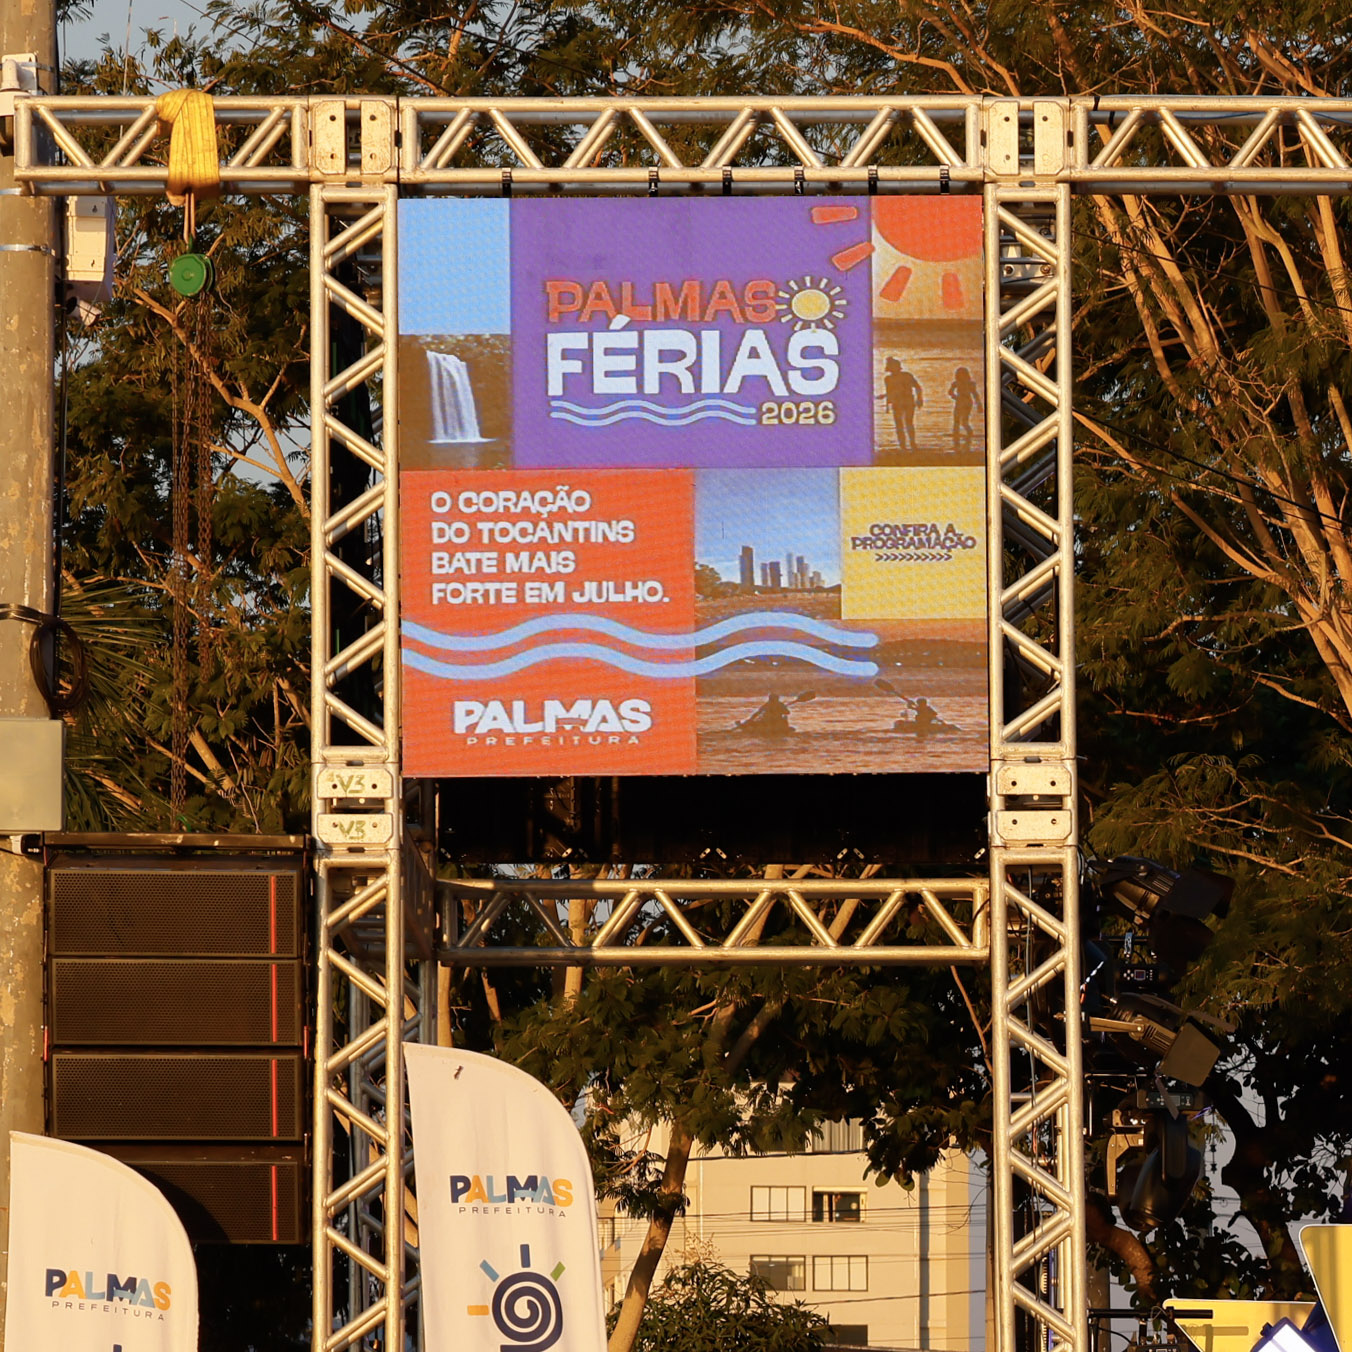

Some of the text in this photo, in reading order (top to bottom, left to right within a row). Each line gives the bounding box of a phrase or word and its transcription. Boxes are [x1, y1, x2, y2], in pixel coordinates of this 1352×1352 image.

[545, 280, 776, 323] PALMAS
[546, 314, 839, 396] FÉRIAS
[762, 401, 835, 425] 2026
[430, 485, 590, 517] O CORAÇÃO
[431, 520, 635, 544] DO TOCANTINS
[869, 523, 941, 537] CONFIRA
[851, 533, 977, 552] PROGRAMAÇÃO
[431, 552, 576, 574] BATE MAIS
[432, 581, 670, 605] FORTE EM JULHO.
[453, 699, 652, 735] PALMAS
[467, 736, 640, 746] PREFEITURA
[450, 1174, 573, 1208] PALMAS
[459, 1206, 567, 1218] PREFEITURA
[44, 1268, 171, 1311] PALMAS
[52, 1301, 165, 1321] PREFEITURA
